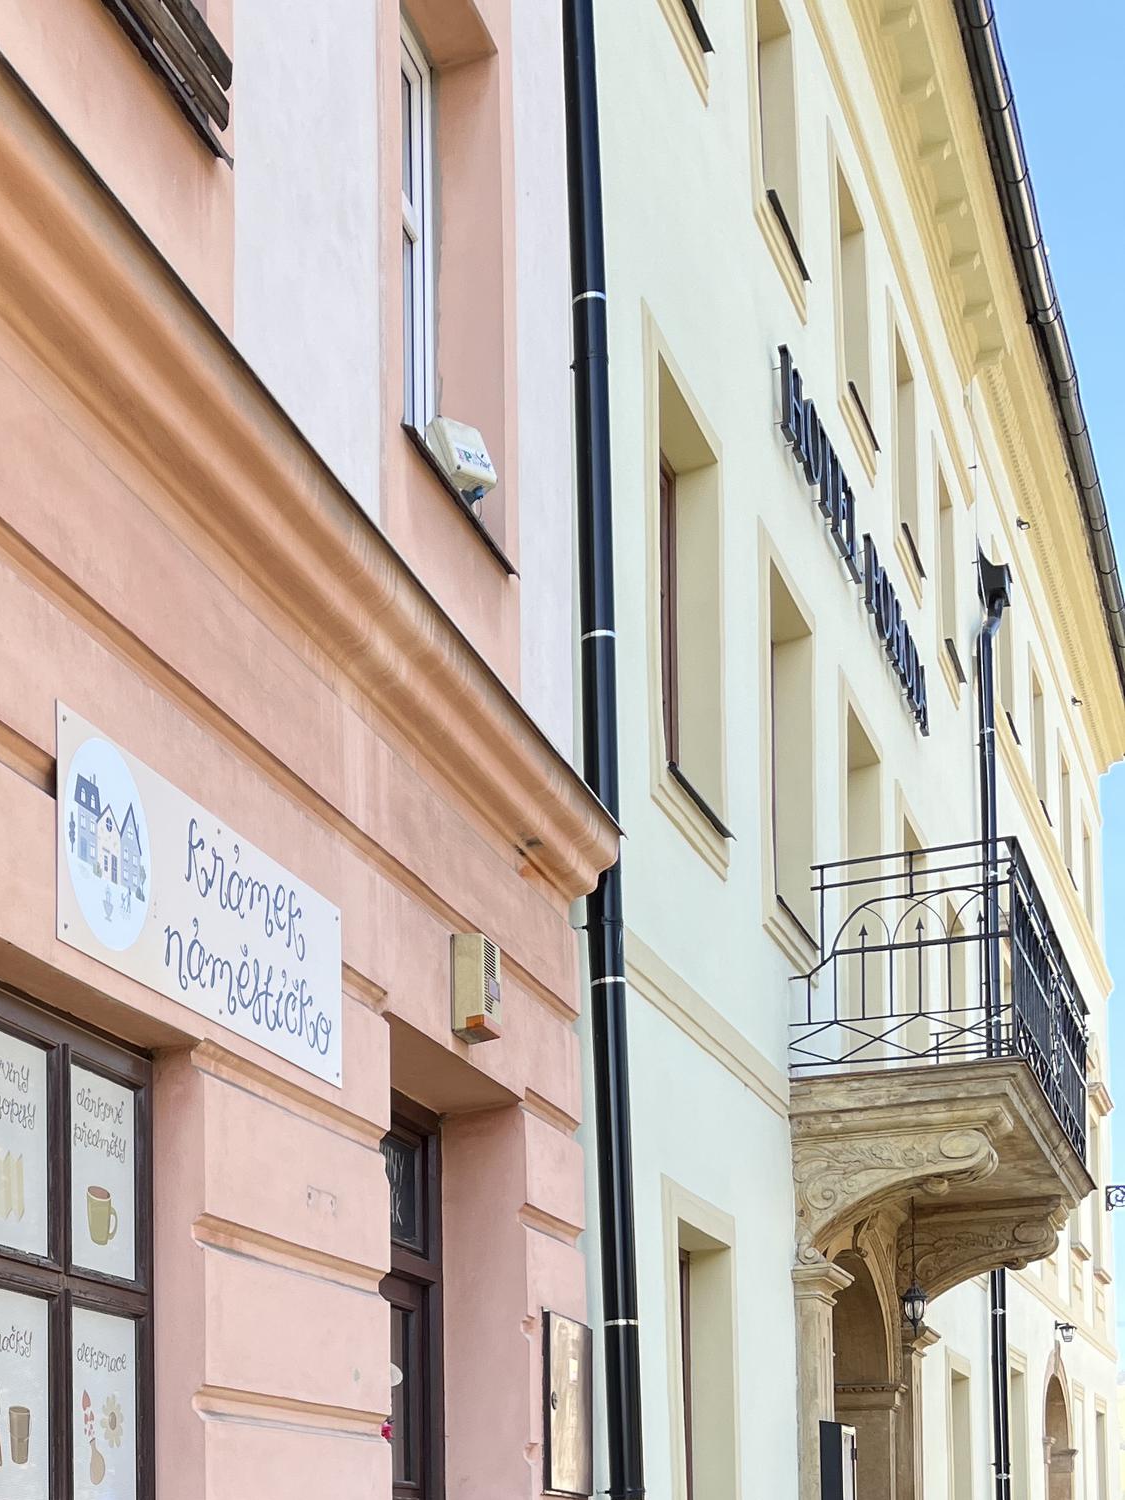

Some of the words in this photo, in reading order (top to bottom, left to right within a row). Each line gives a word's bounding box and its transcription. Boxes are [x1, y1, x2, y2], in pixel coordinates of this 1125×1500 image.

[778, 344, 862, 585] HOTEL
[184, 817, 306, 962] krámek
[76, 1342, 127, 1373] dekorace
